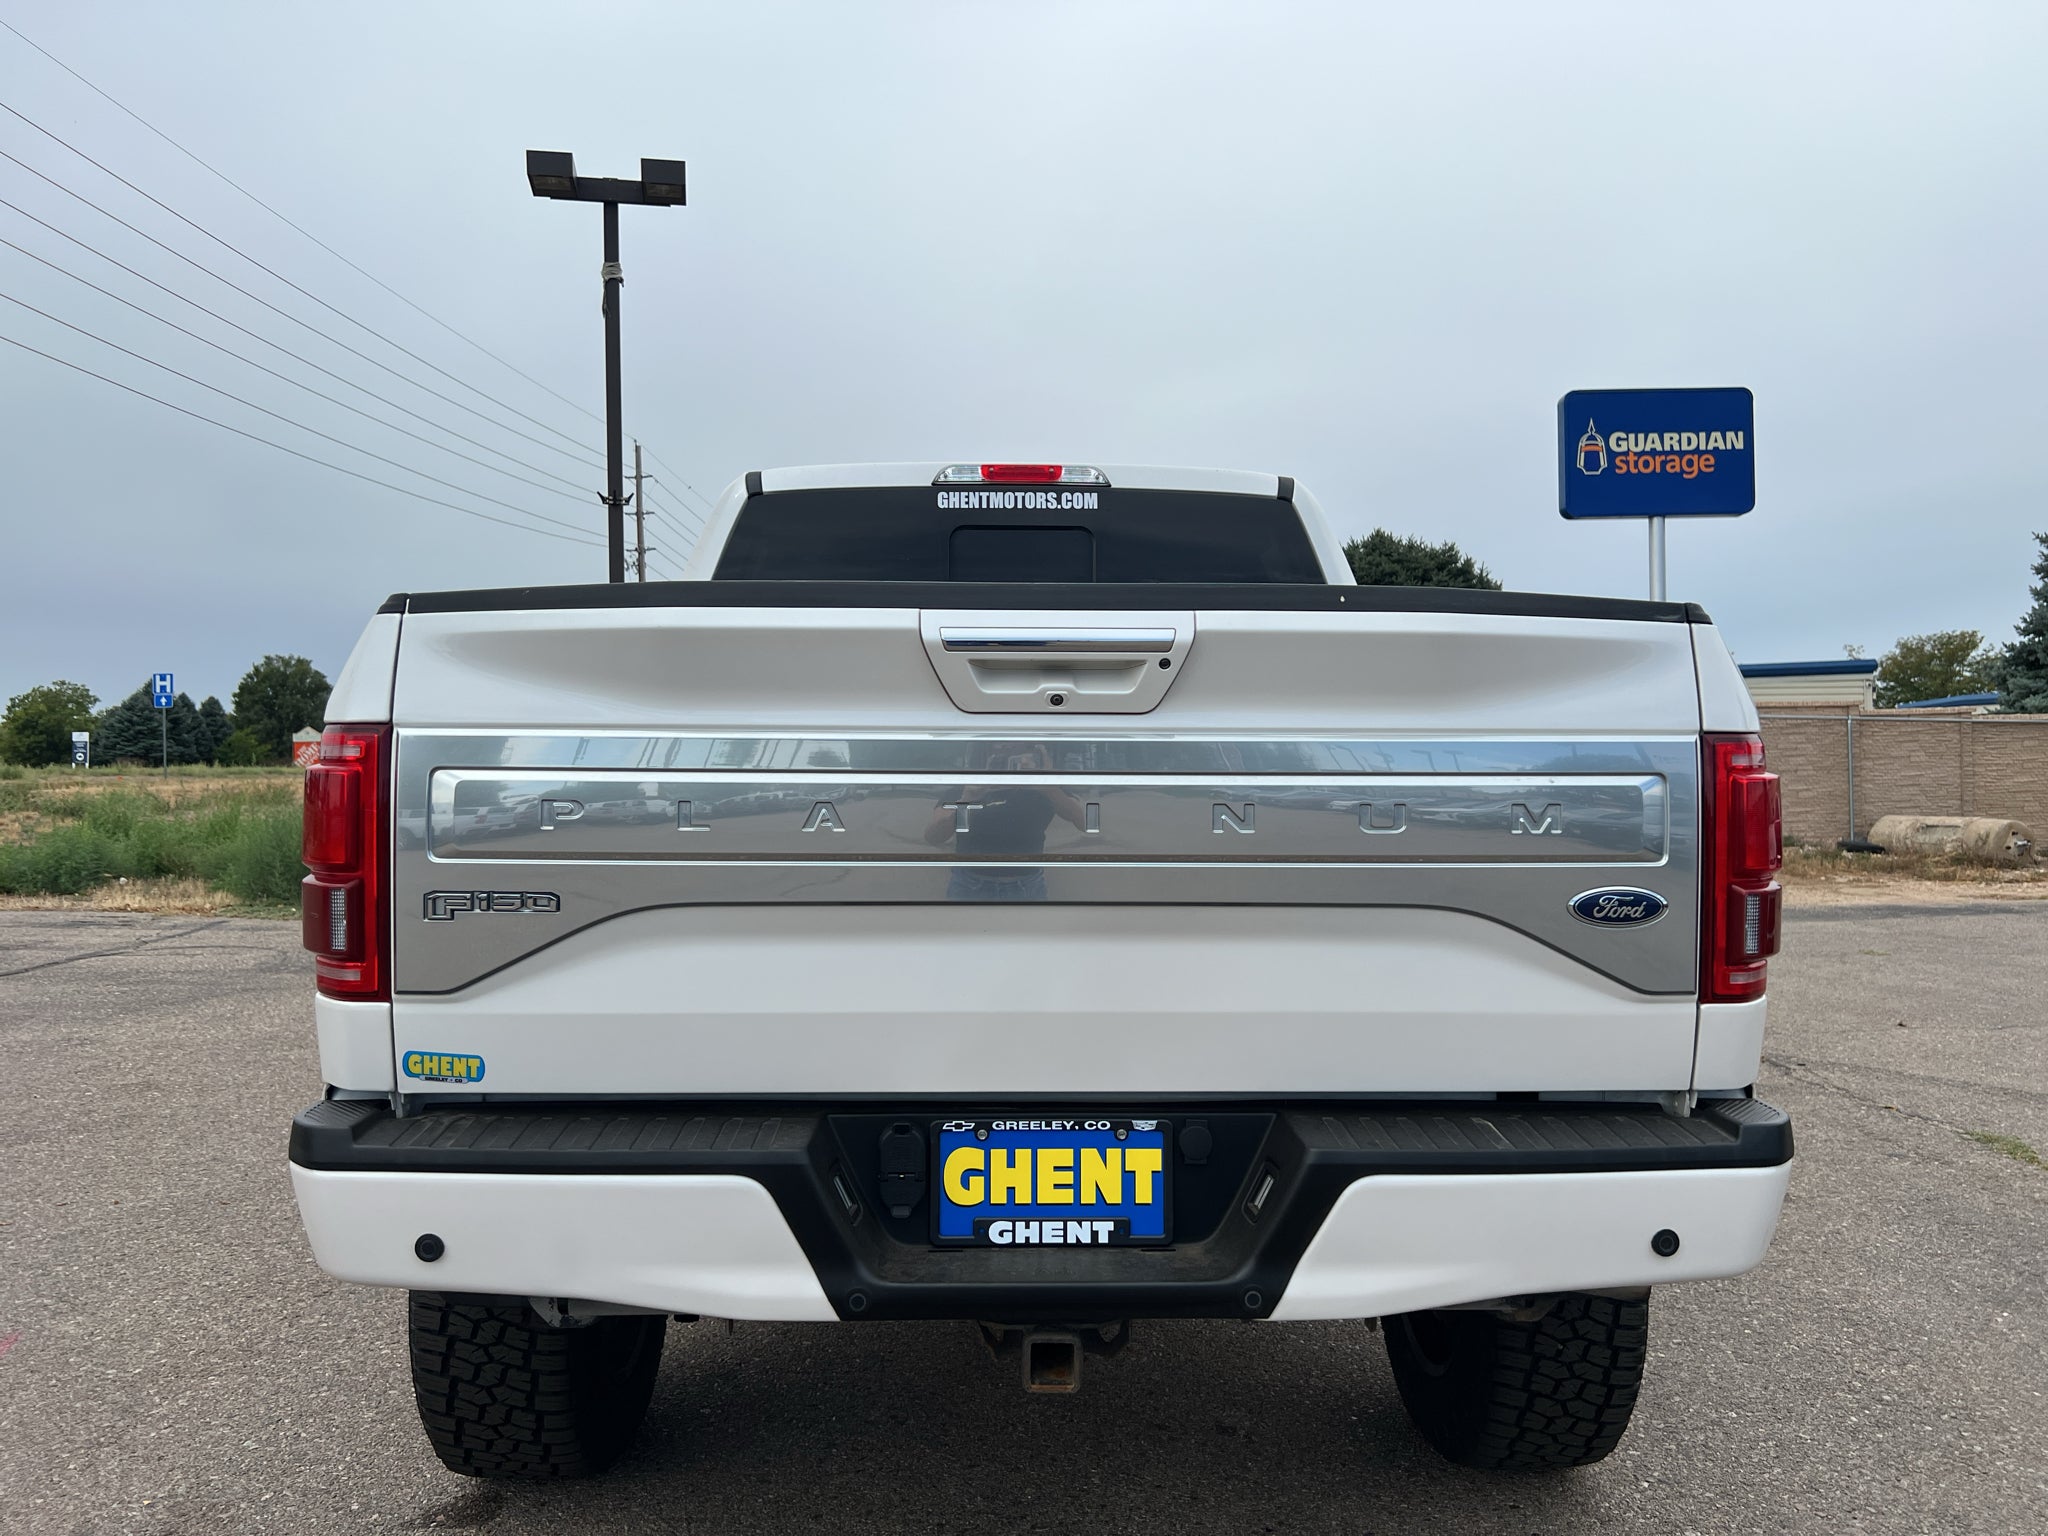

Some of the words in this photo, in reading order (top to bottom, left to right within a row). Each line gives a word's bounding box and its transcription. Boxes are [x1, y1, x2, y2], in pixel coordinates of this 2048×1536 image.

[1608, 431, 1744, 452] GUARDIAN
[1615, 451, 1715, 479] storage
[937, 491, 1098, 510] GHENTMOTORS.COM
[155, 674, 171, 693] H
[539, 799, 1564, 837] PLATINUM
[1593, 895, 1647, 918] Ford
[408, 1053, 481, 1078] GHENT
[992, 1120, 1079, 1131] GREELEY,
[1084, 1120, 1111, 1131] CO
[943, 1146, 1162, 1206] GHENT
[988, 1220, 1115, 1245] GHENT
